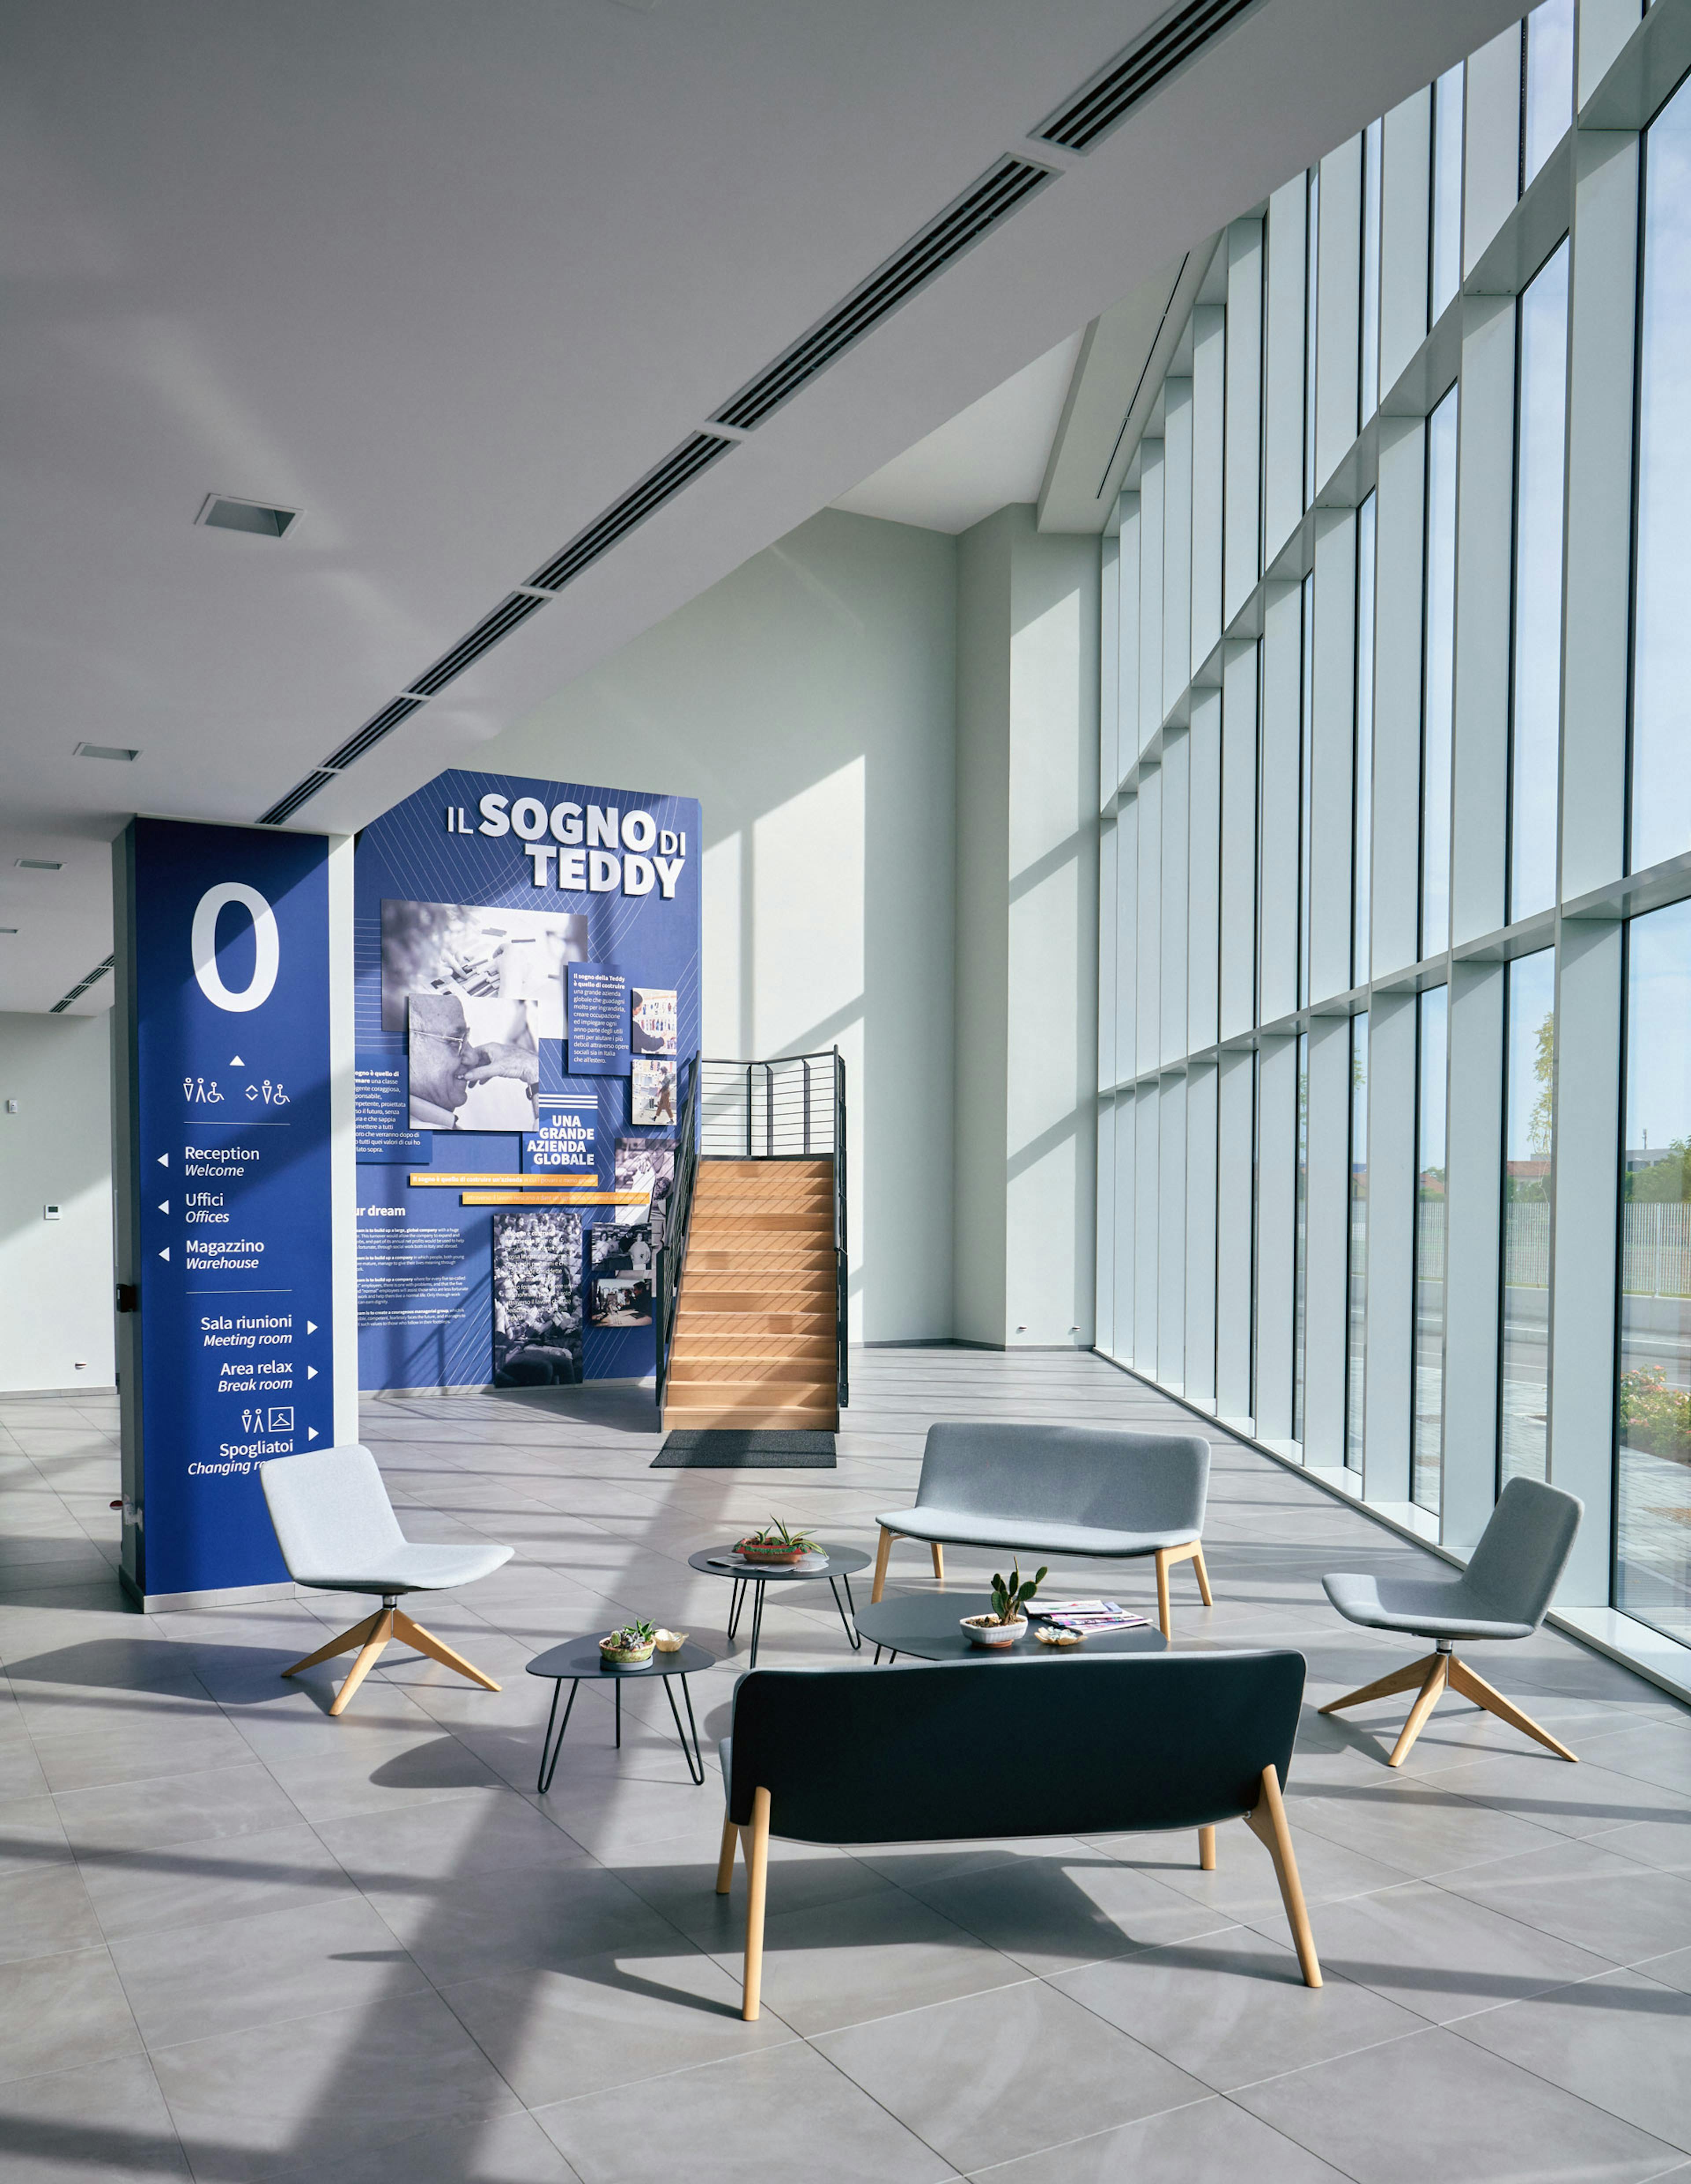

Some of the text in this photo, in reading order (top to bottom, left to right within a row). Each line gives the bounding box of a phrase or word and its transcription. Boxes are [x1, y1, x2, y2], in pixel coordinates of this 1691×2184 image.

[448, 793, 686, 856] IL SOGNO DI
[524, 843, 685, 898] TEDDY
[192, 882, 280, 1013] 0
[552, 1115, 581, 1127] UNA
[539, 1128, 594, 1140] GRANDE
[527, 1140, 586, 1152] AZIENDA
[185, 1146, 260, 1164] Reception
[534, 1153, 594, 1166] GLOBALE
[185, 1164, 244, 1177] Welcome
[185, 1192, 224, 1207] Uffici
[185, 1210, 230, 1224] Offices
[355, 1205, 406, 1216] ur dream
[186, 1238, 265, 1257] Magazzino
[186, 1257, 259, 1270] Warehouse
[200, 1314, 292, 1331] Sala riunioni
[203, 1334, 292, 1348] Meeting room
[220, 1360, 293, 1376] Area relax
[218, 1379, 293, 1393] Break room
[219, 1439, 294, 1459] Spogliatoi
[188, 1460, 251, 1476] Changing
